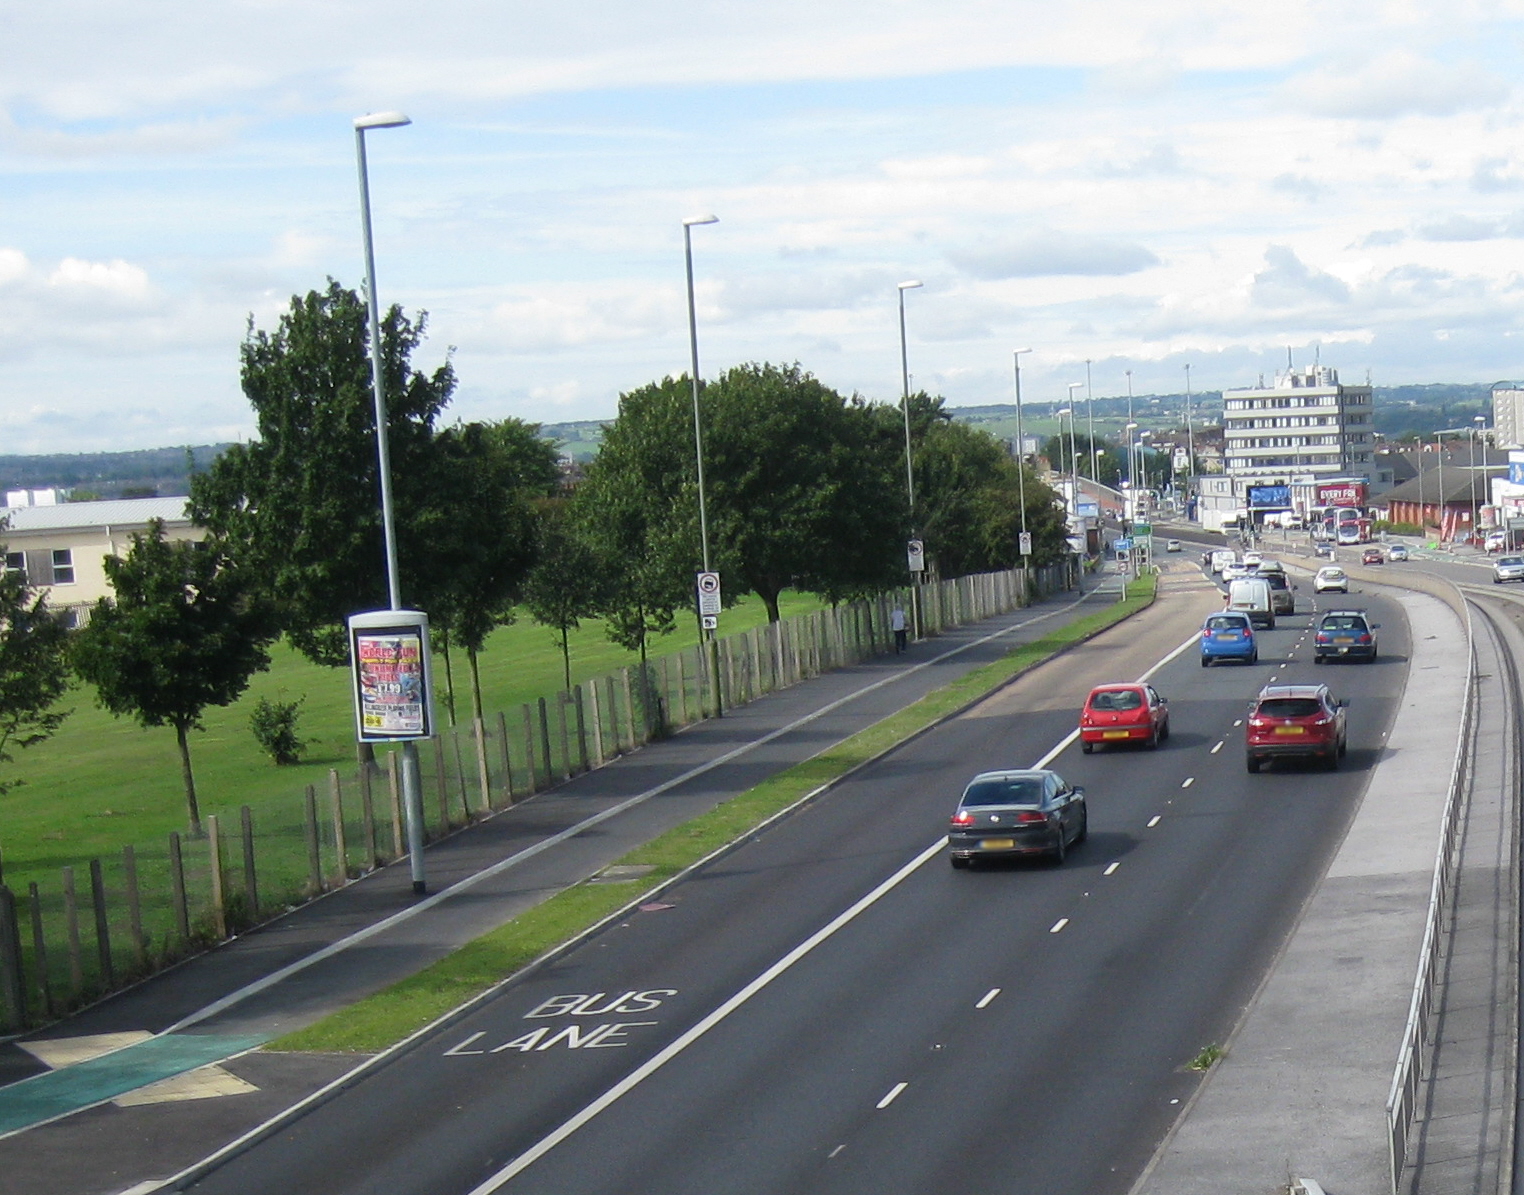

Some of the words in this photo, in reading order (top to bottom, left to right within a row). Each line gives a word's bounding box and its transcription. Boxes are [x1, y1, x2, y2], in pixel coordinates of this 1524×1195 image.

[1320, 488, 1342, 499] EVERY
[522, 988, 678, 1019] BUS
[443, 1021, 658, 1056] LANE
